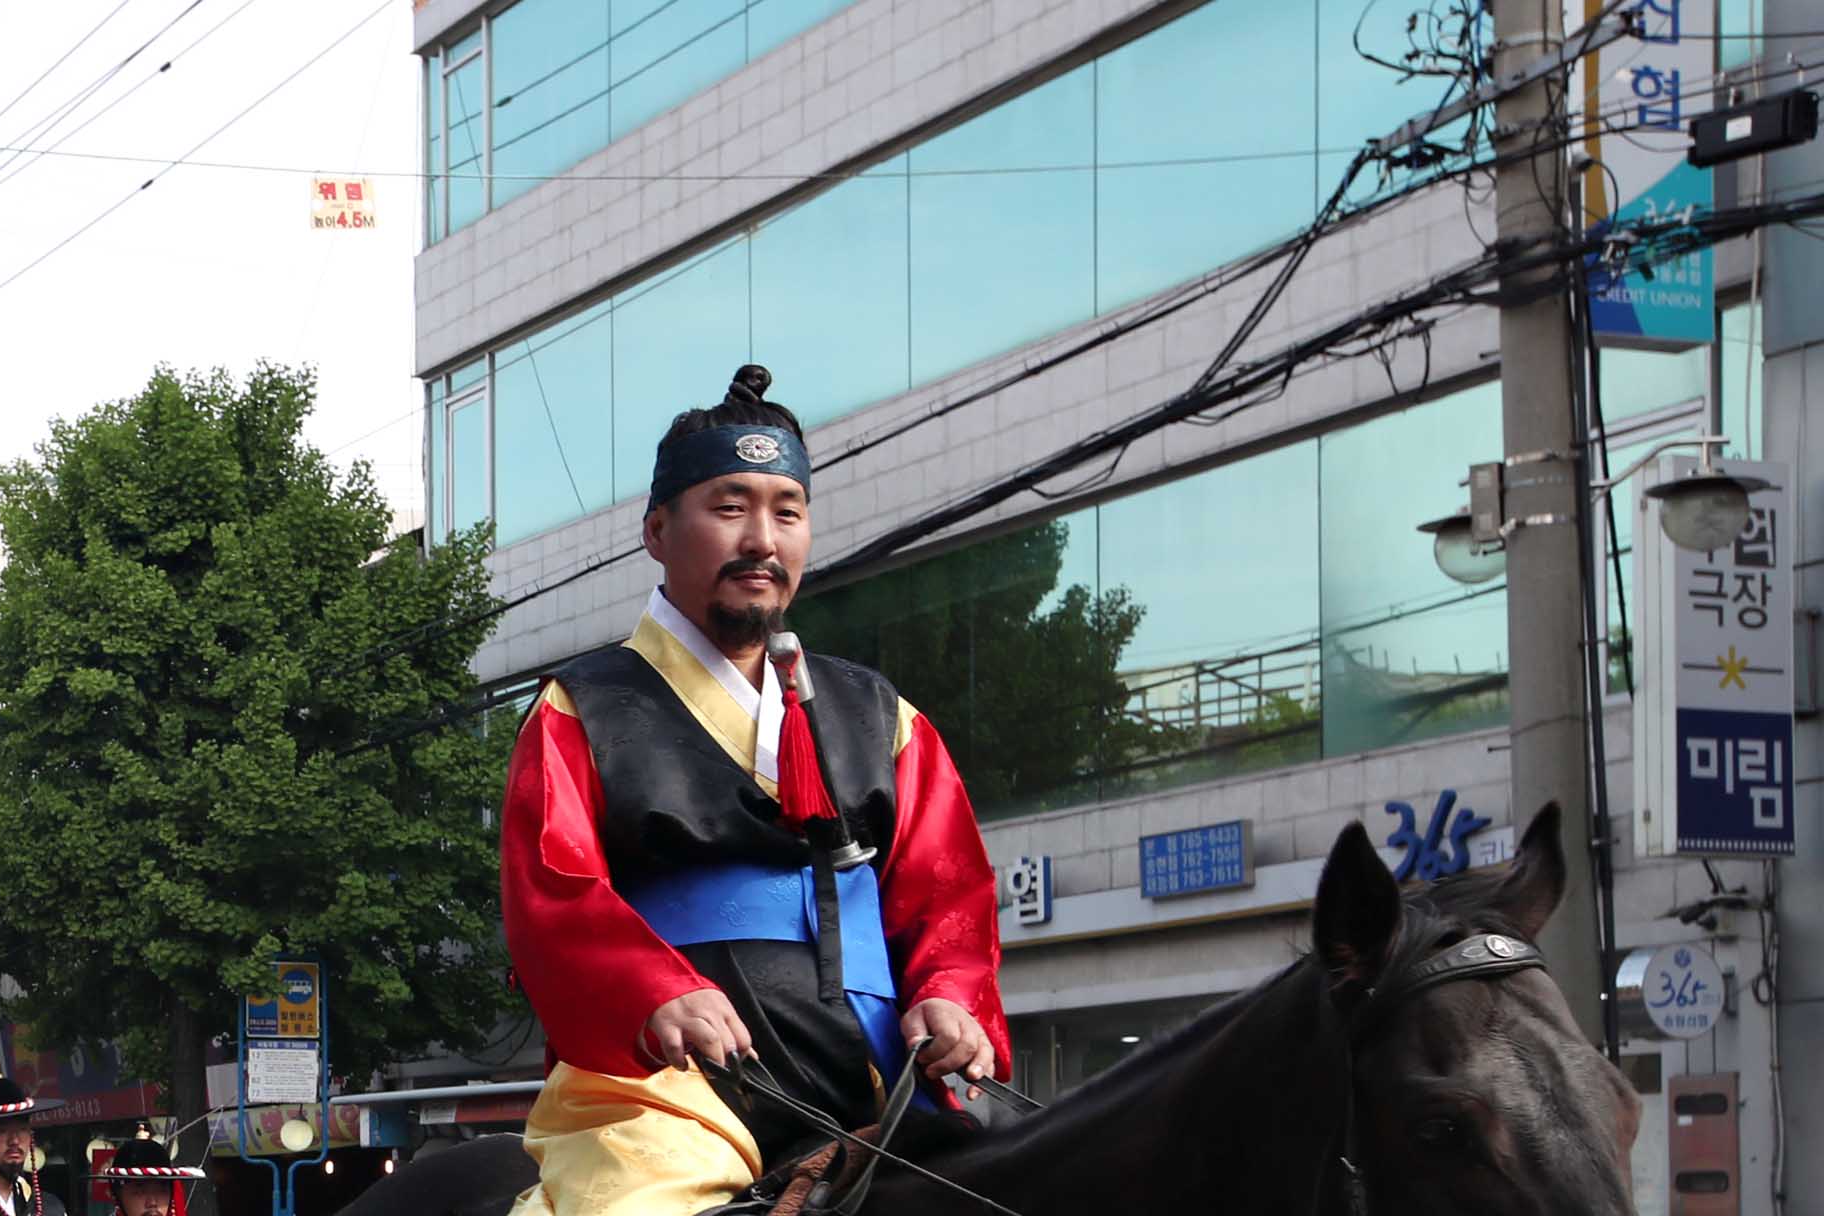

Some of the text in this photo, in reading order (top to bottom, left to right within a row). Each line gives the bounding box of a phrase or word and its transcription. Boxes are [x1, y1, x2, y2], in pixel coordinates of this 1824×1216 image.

[1596, 284, 1702, 309] CREDIT UNION
[1688, 569, 1773, 630] 극장
[1685, 737, 1785, 829] 미림
[1384, 788, 1492, 882] 365
[1647, 969, 1708, 1009] 365
